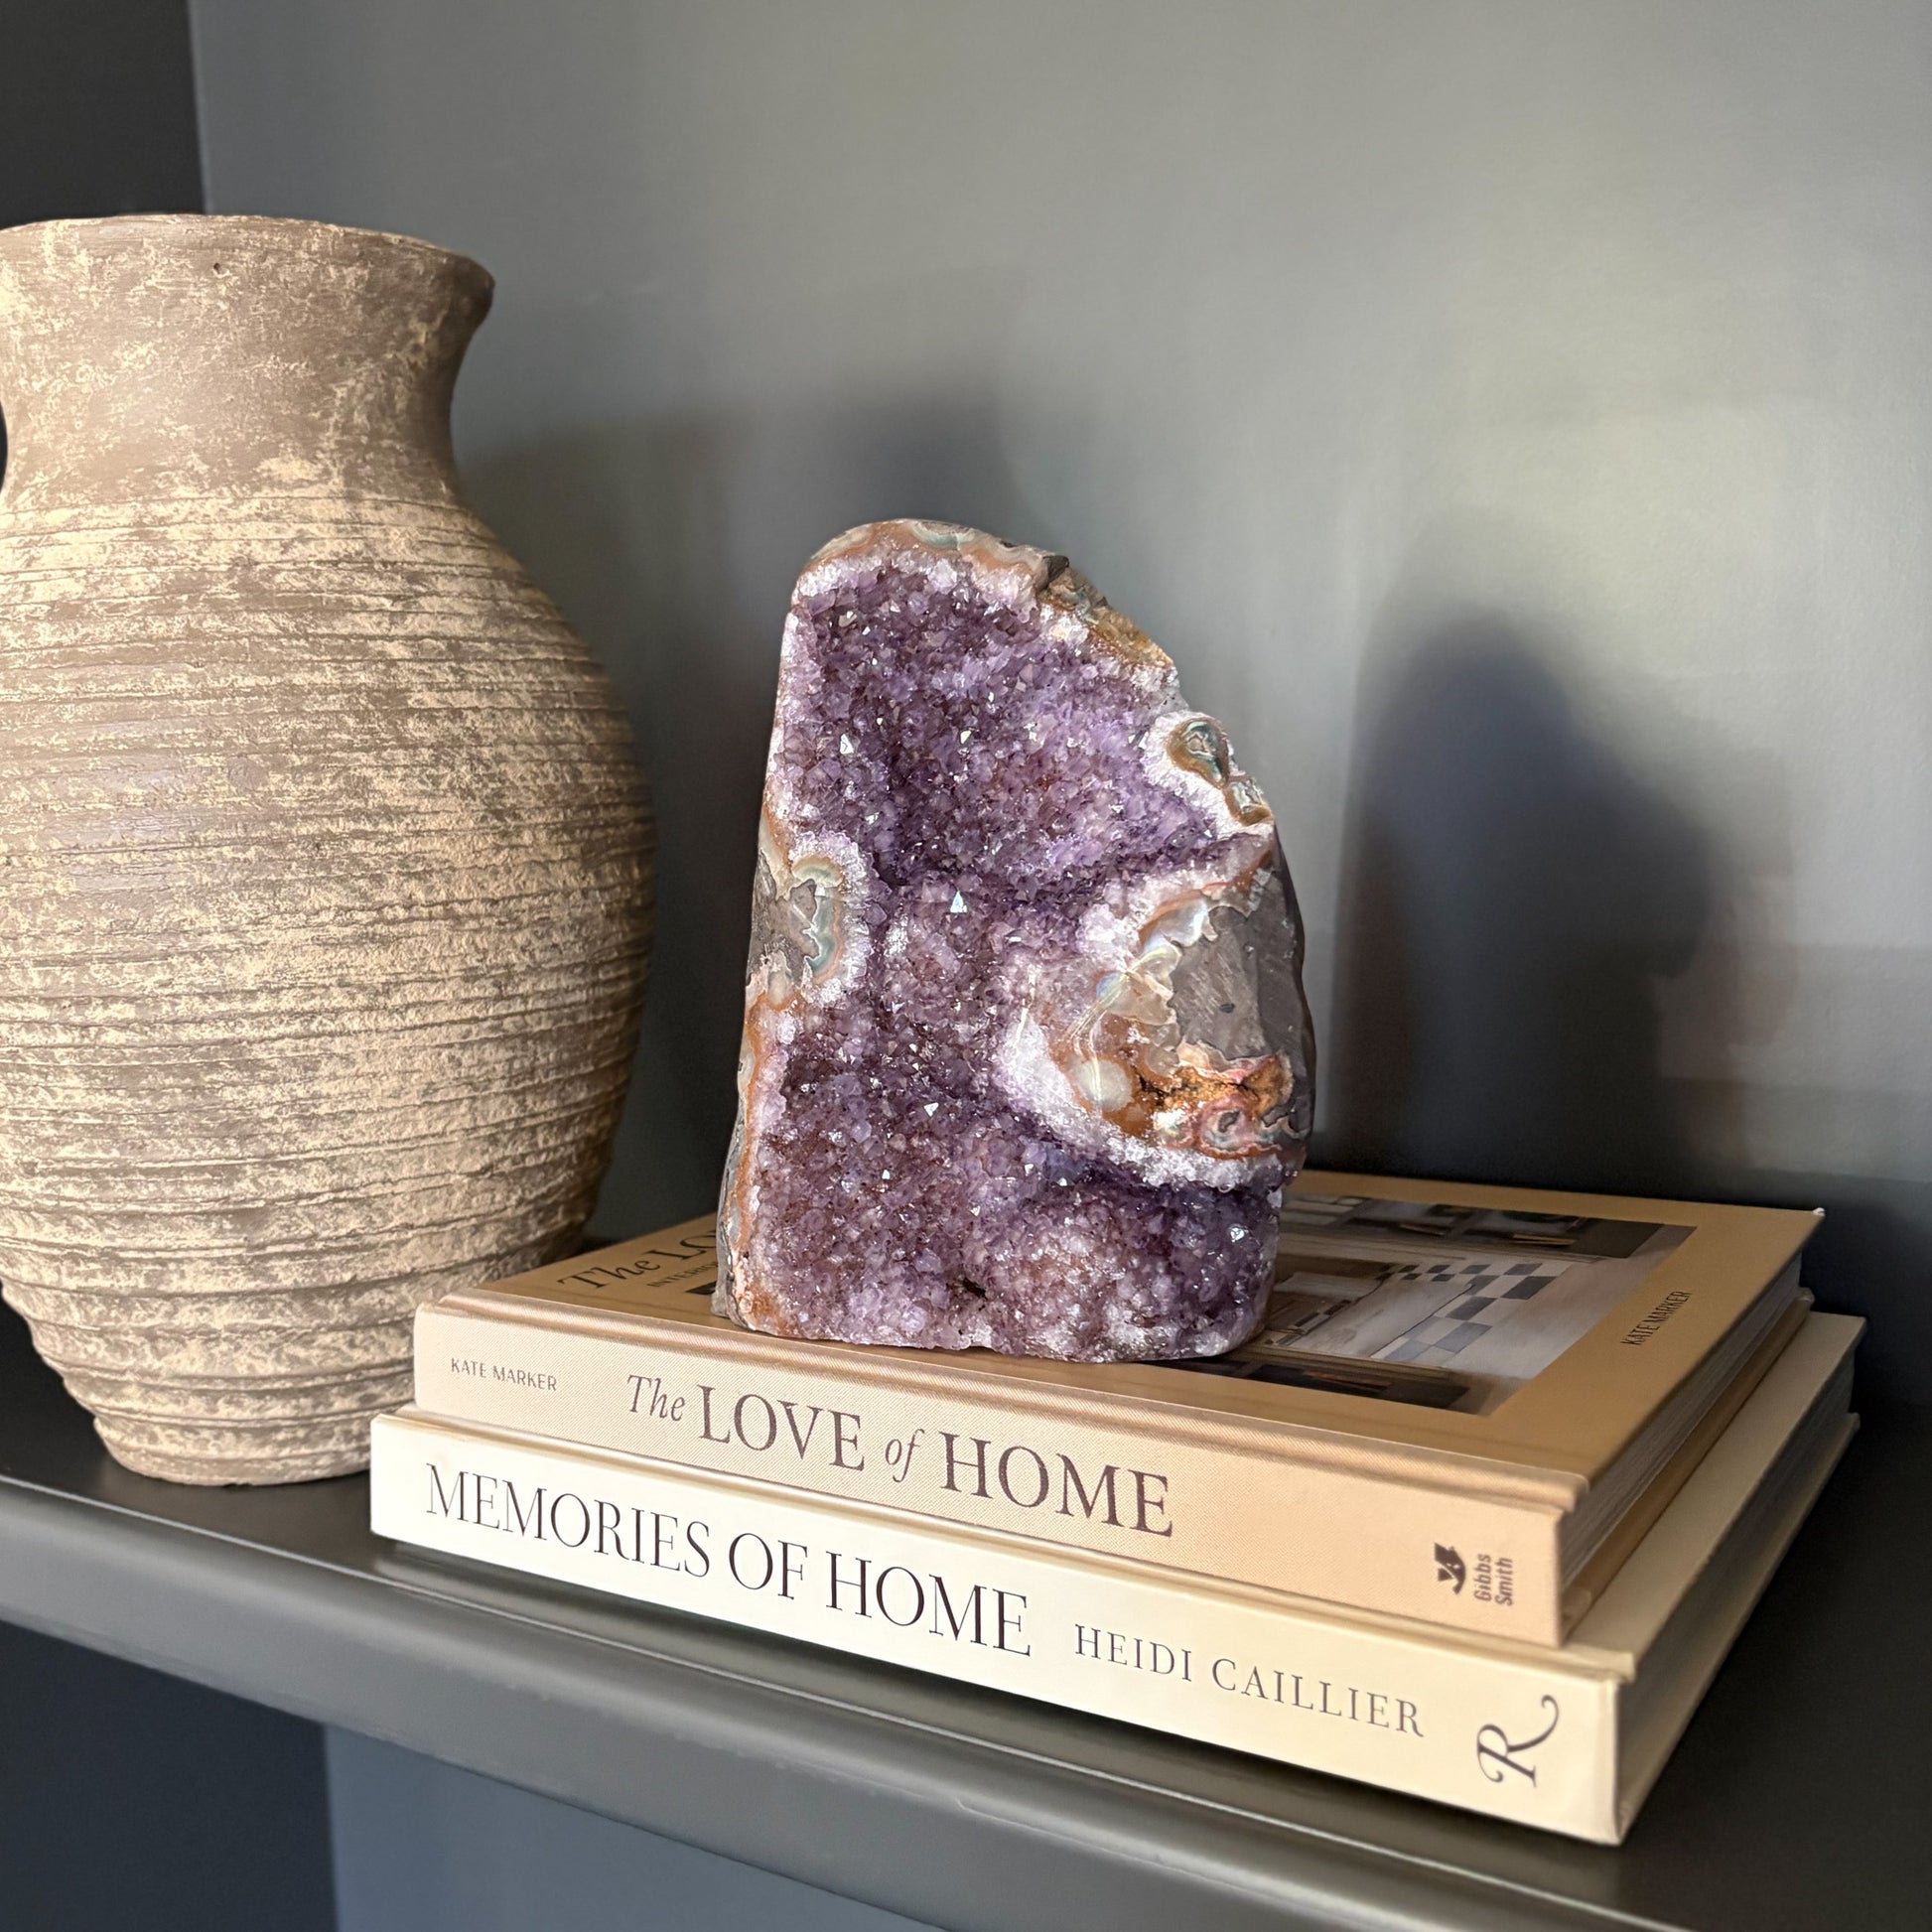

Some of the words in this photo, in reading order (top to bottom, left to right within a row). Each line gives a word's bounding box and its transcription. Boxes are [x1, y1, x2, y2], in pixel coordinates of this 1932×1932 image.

[557, 1259, 660, 1289] The
[642, 1228, 717, 1261] LO
[1620, 1324, 1661, 1345] KATE
[1642, 1291, 1694, 1323] MARKER
[451, 1357, 486, 1379] KATE
[492, 1365, 557, 1392] MARKER
[627, 1374, 686, 1422] The
[697, 1384, 865, 1471] LOVE
[885, 1429, 925, 1483] of
[938, 1431, 1173, 1538] HOME
[426, 1462, 711, 1578] MEMORIES
[729, 1533, 808, 1599] OF
[826, 1551, 1031, 1657] HOME
[1473, 1553, 1492, 1601] Gibbs
[1494, 1557, 1513, 1606] Smith
[1075, 1623, 1192, 1682] HEIDI
[1211, 1658, 1424, 1737] CAILLIER
[1476, 1694, 1560, 1787] R
